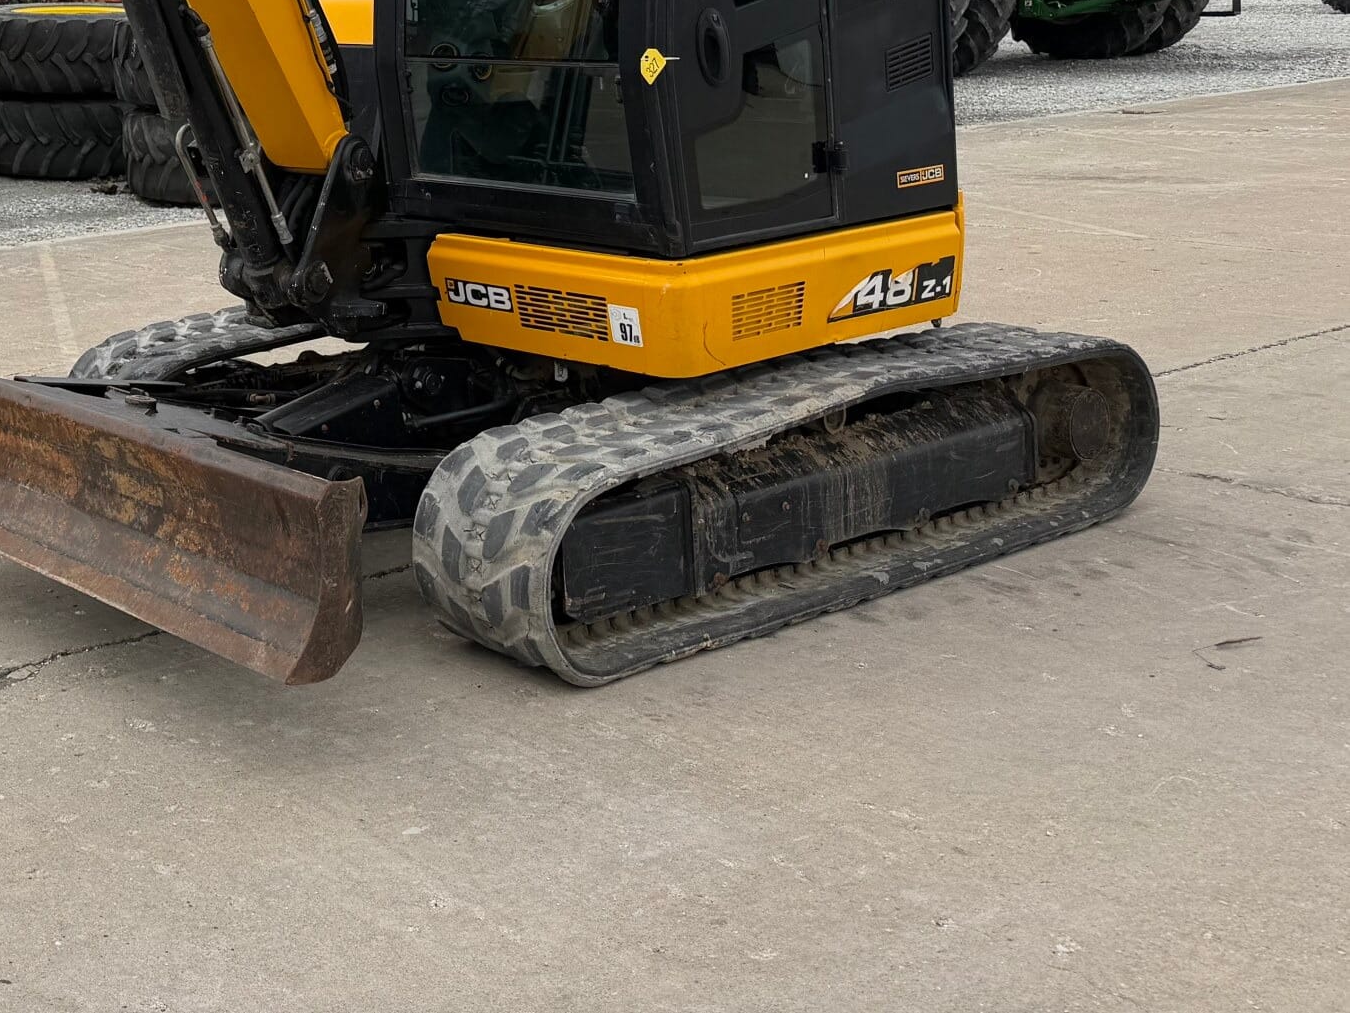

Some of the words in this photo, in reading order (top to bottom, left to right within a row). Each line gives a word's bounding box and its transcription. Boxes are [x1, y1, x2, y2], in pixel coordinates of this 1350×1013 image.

[645, 57, 660, 78] 327
[921, 167, 942, 180] JCB
[448, 281, 512, 310] JCB
[856, 271, 914, 309] 48
[921, 275, 952, 299] Z-1
[619, 322, 633, 342] 97
